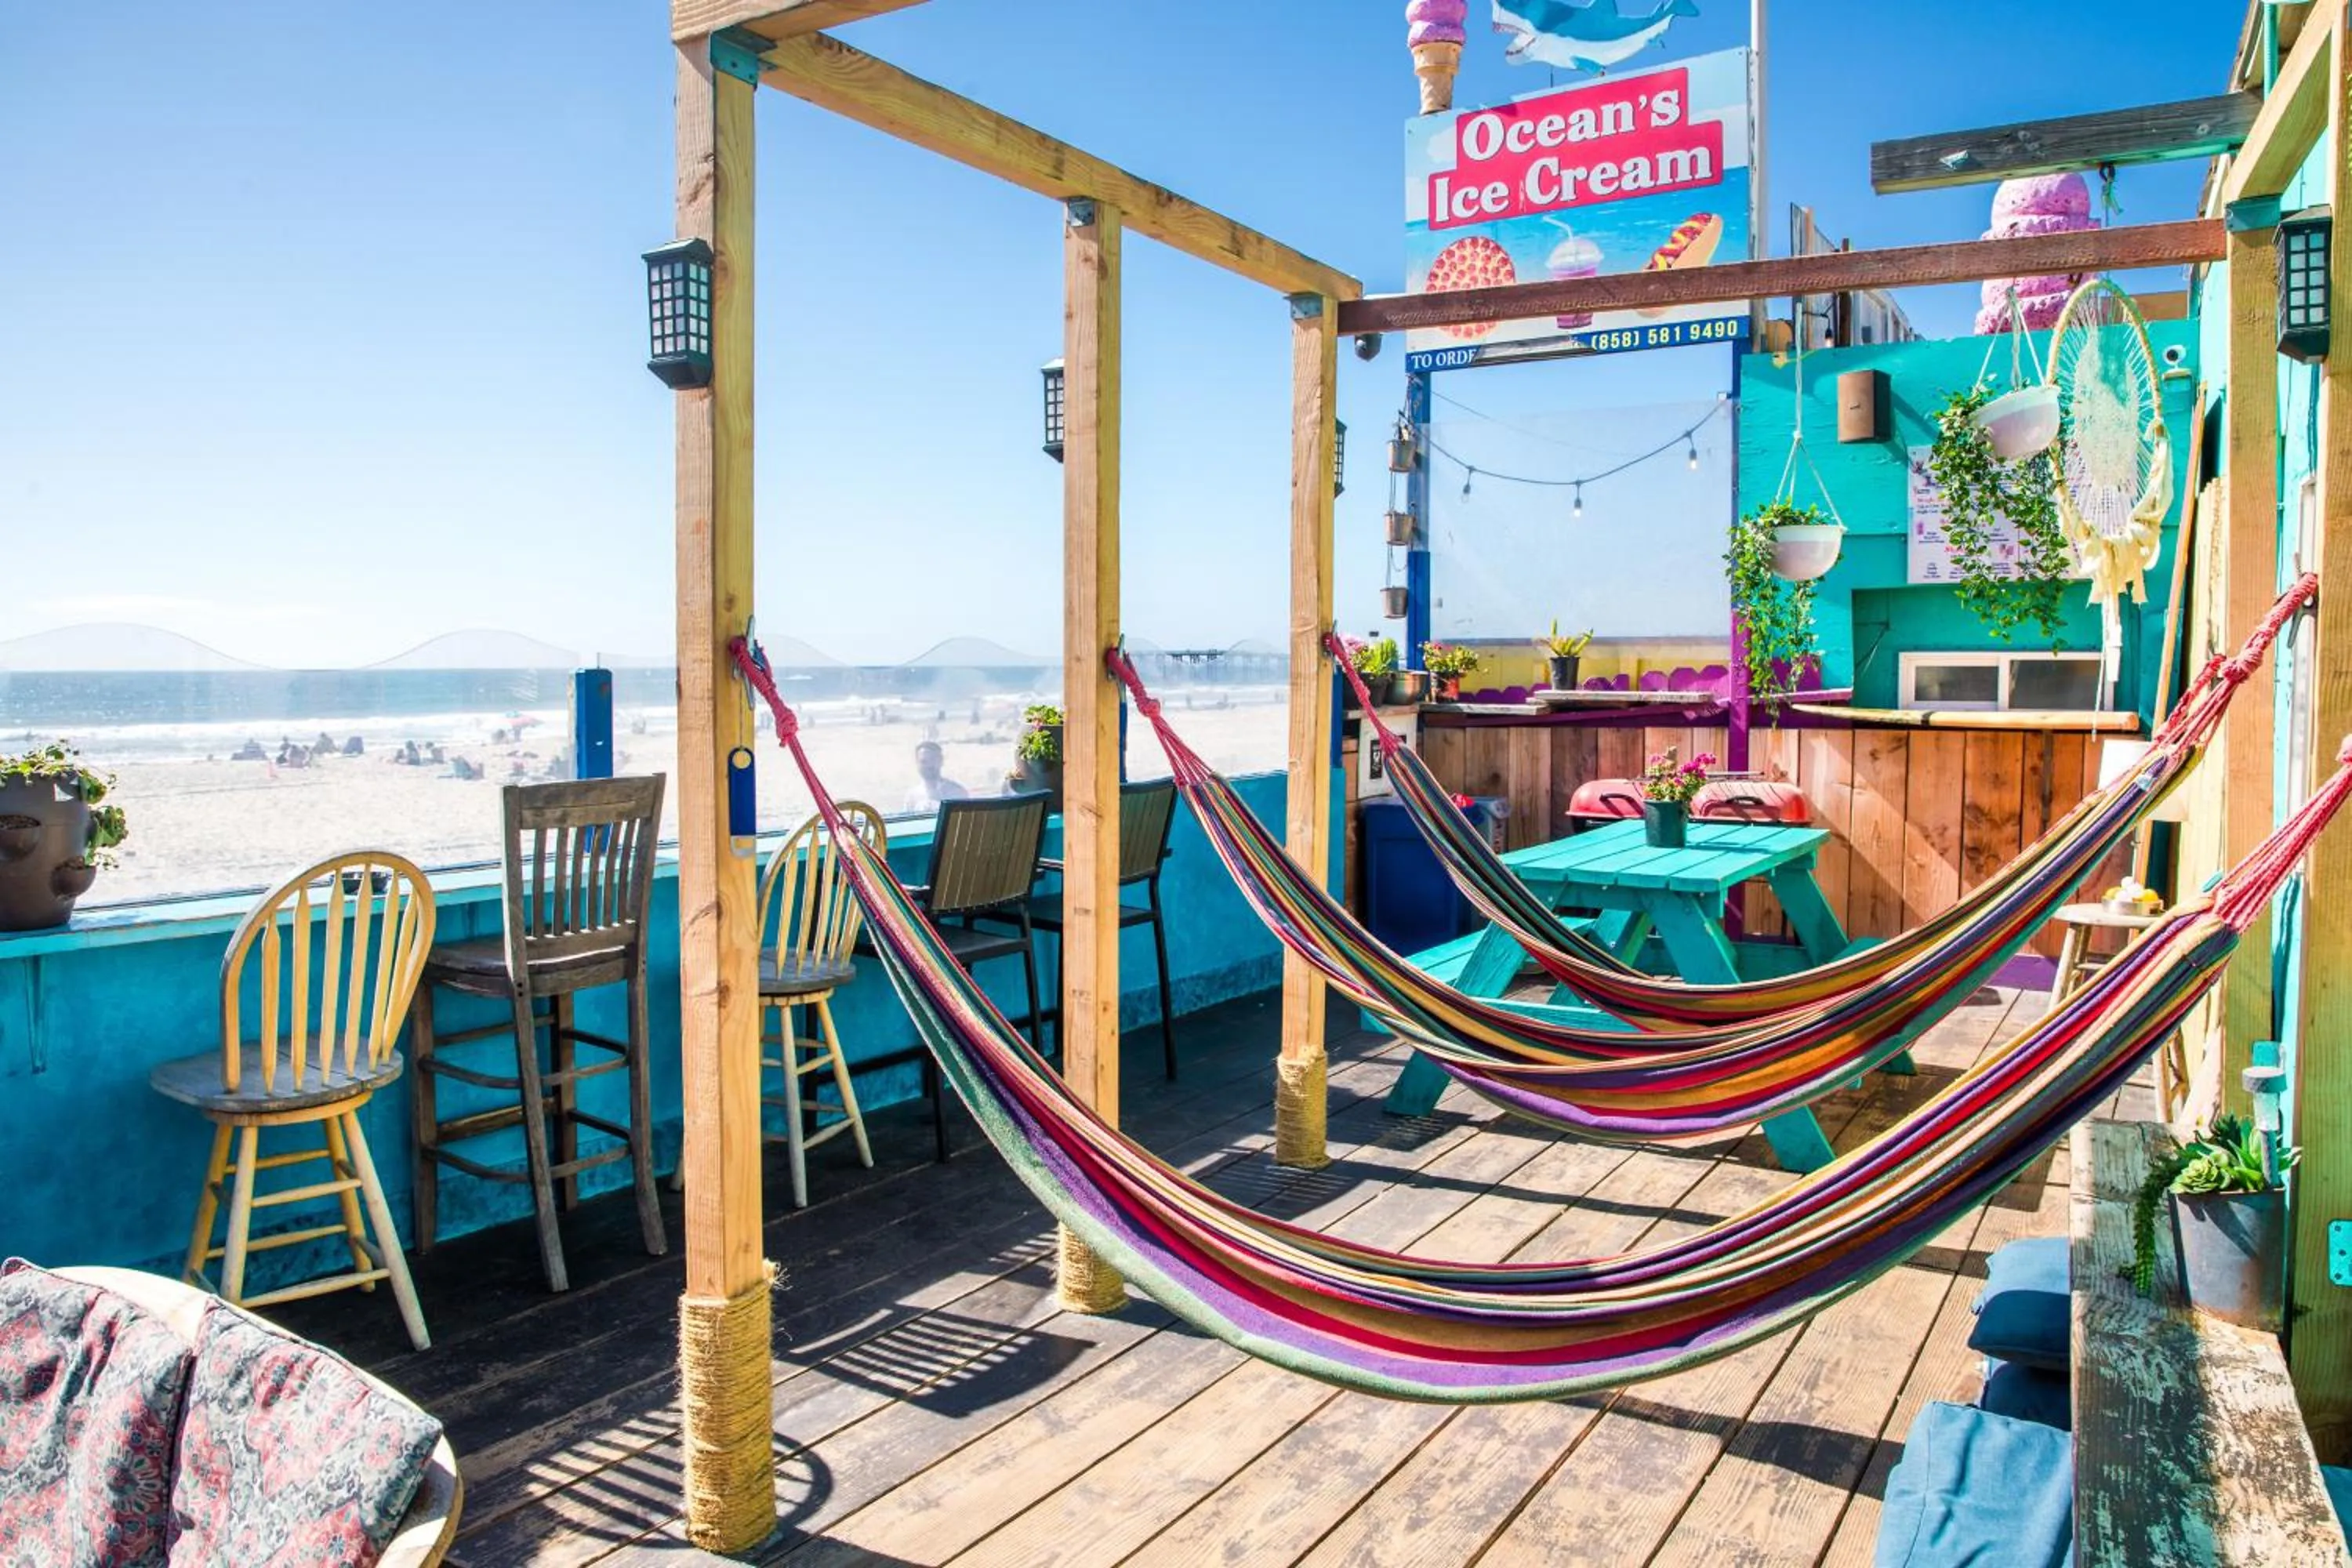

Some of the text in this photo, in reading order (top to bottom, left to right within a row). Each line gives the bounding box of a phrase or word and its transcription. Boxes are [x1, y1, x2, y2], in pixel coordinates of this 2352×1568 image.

[1461, 88, 1681, 162] Ocean's
[1434, 144, 1713, 223] Ice Cream
[1410, 353, 1432, 369] TO
[1591, 330, 1640, 351] (858)
[1648, 325, 1681, 345] 581
[1690, 319, 1738, 340] 9490
